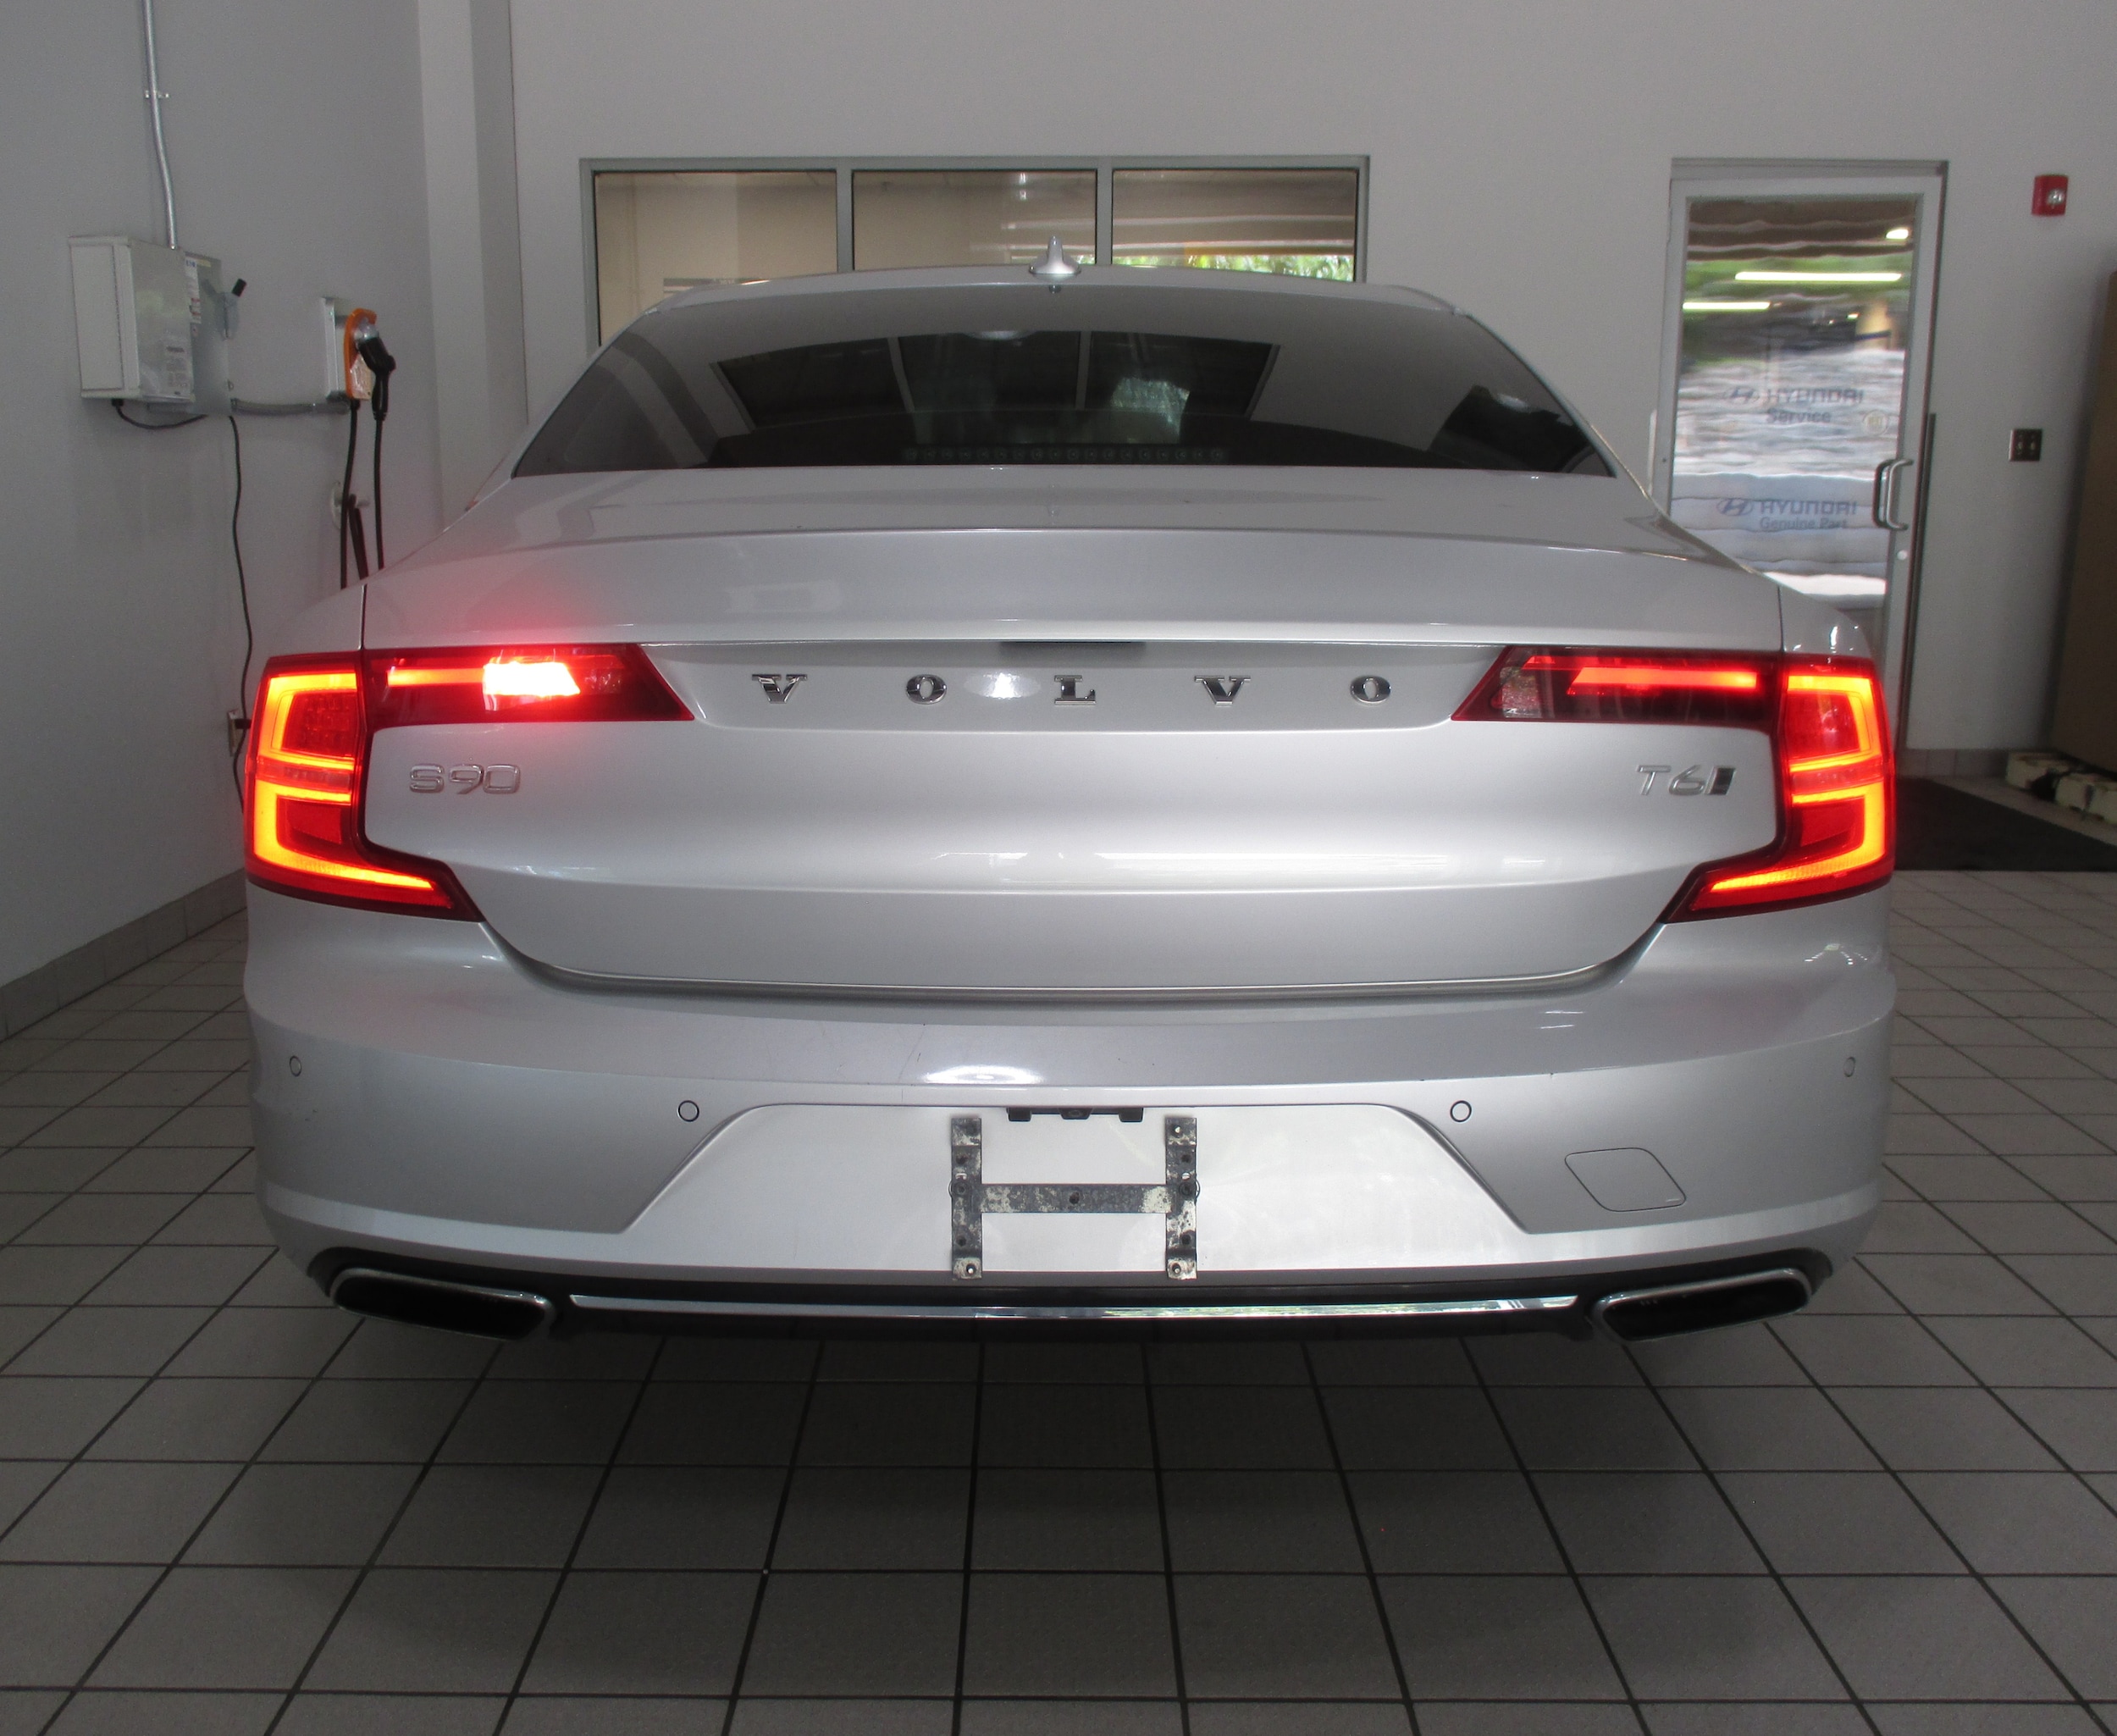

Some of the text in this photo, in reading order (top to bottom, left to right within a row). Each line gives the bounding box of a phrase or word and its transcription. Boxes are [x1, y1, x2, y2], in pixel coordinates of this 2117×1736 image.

[1767, 407, 1831, 423] Service
[1760, 500, 1857, 515] HYUNDAI
[1760, 516, 1816, 530] Genuine
[751, 673, 1392, 706] VOLVO
[409, 763, 521, 794] S90
[1637, 765, 1705, 796] T6
